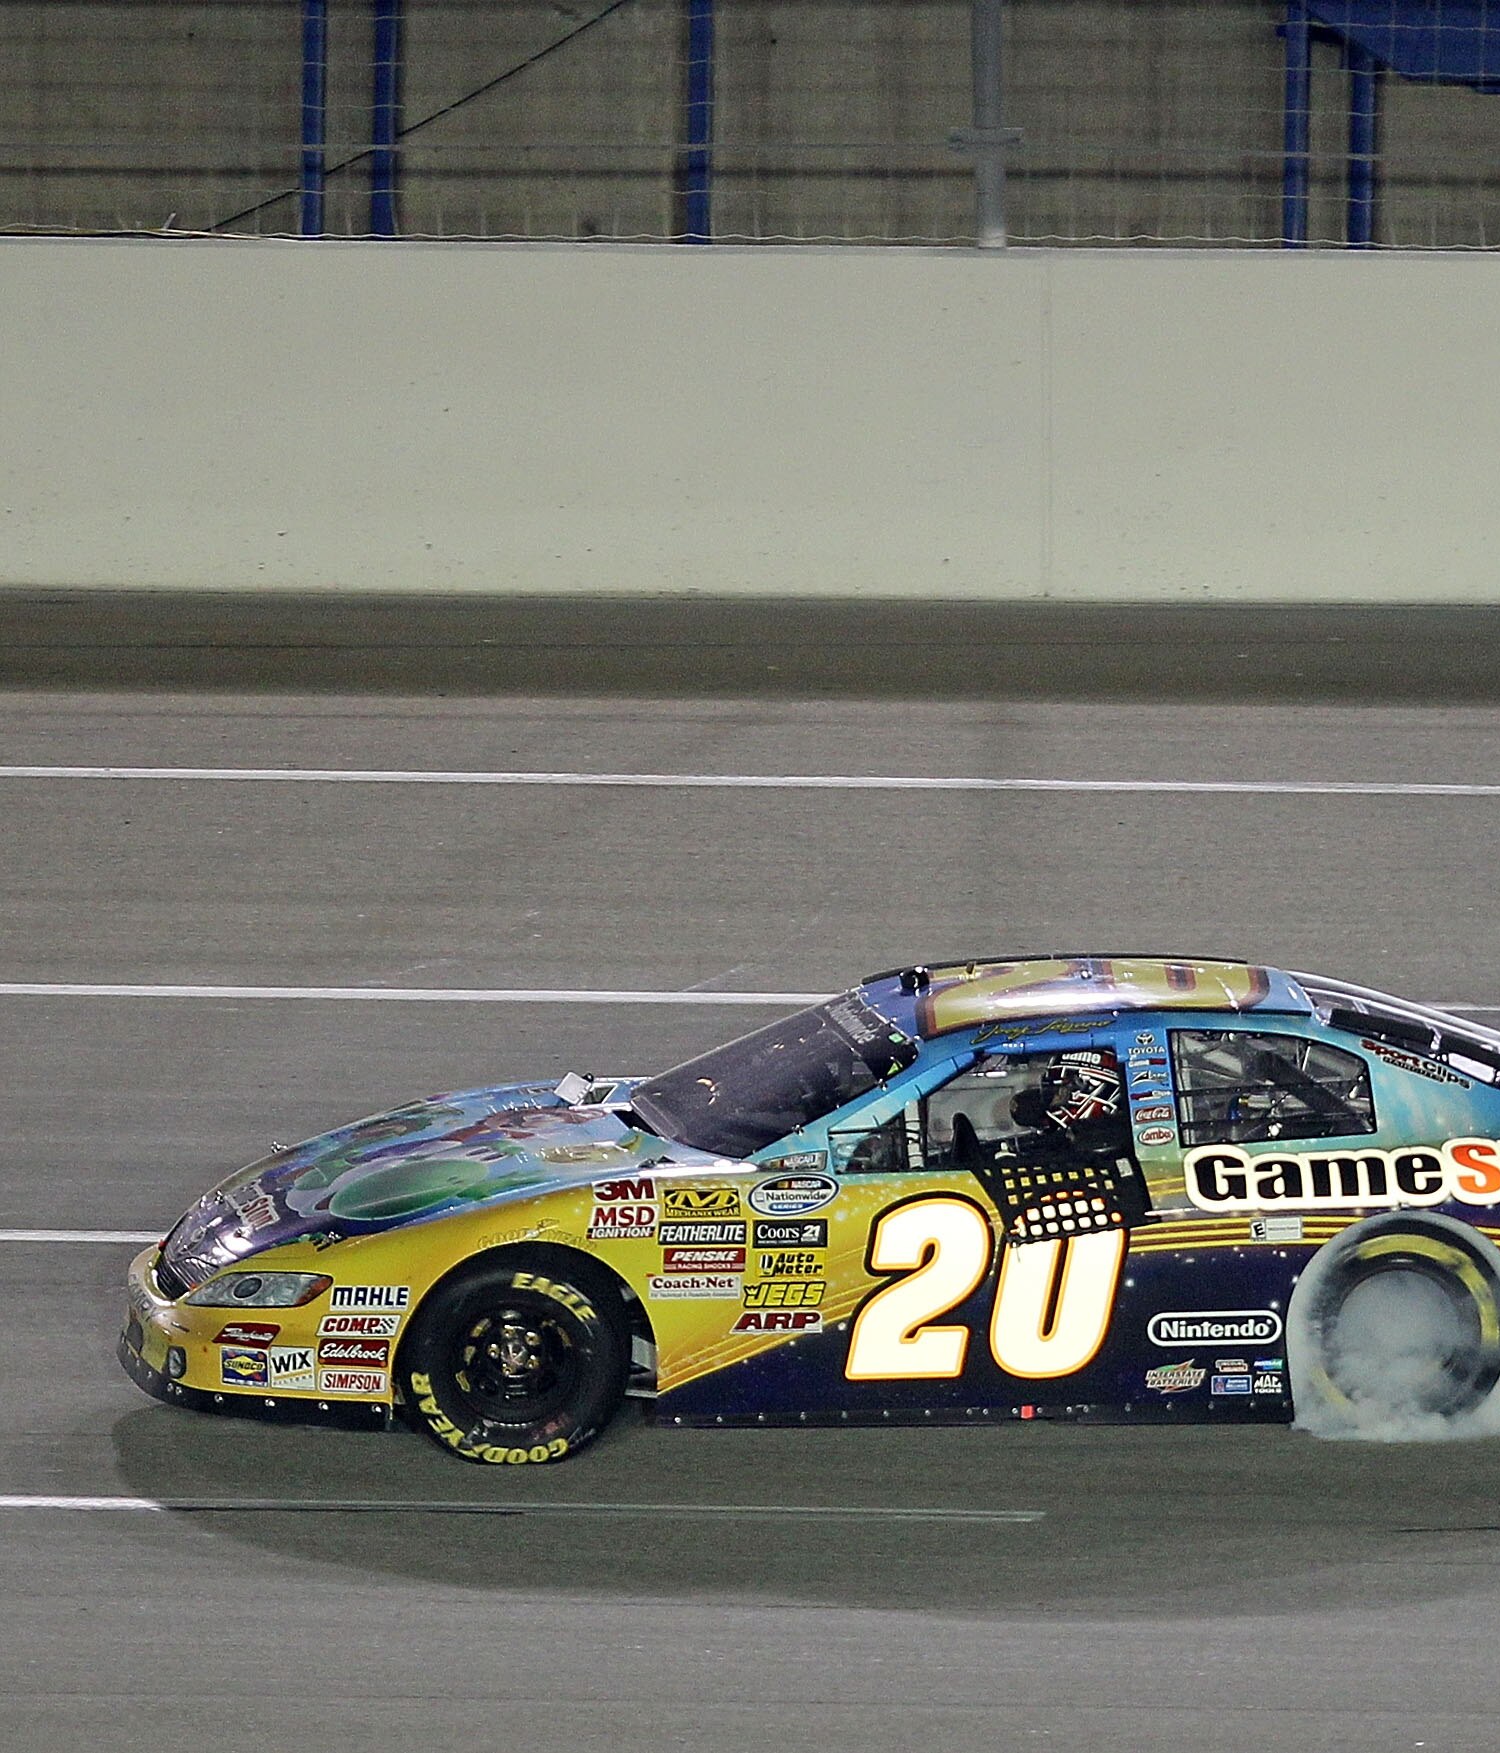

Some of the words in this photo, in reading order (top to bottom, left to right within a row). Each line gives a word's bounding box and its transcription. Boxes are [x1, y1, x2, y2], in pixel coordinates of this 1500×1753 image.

[1128, 1046, 1166, 1055] TOYOTA
[1361, 1040, 1421, 1067] Sport
[1422, 1061, 1470, 1089] Clips
[595, 1179, 655, 1201] 3M
[791, 1180, 822, 1188] NASCAR
[765, 1191, 827, 1201] Nationwide
[593, 1207, 655, 1228] MSD
[666, 1208, 712, 1217] MECHANIX
[714, 1207, 740, 1217] WEAR
[590, 1227, 650, 1239] IGNITION
[660, 1225, 744, 1242] FEATHERLITE
[757, 1225, 800, 1239] Coors
[802, 1225, 821, 1237] 21
[671, 1250, 738, 1262] PENSKE
[774, 1252, 815, 1263] Auto
[773, 1263, 823, 1275] Meter
[652, 1277, 734, 1289] Coach-Net
[845, 1193, 1124, 1380] 20
[332, 1287, 408, 1306] MAHLE
[512, 1272, 597, 1322] EAGLE
[754, 1282, 826, 1306] JEGS
[322, 1318, 383, 1333] COMP
[734, 1312, 820, 1330] ARP
[1160, 1319, 1270, 1338] Nintendo
[319, 1343, 388, 1362] Edelbrock
[224, 1359, 265, 1372] SUNOCO
[271, 1351, 312, 1374] WIX
[324, 1373, 382, 1392] SIMPSON
[1147, 1370, 1205, 1380] INTERSTATE
[1254, 1375, 1282, 1388] MAC
[411, 1371, 569, 1465] GOODYEAR
